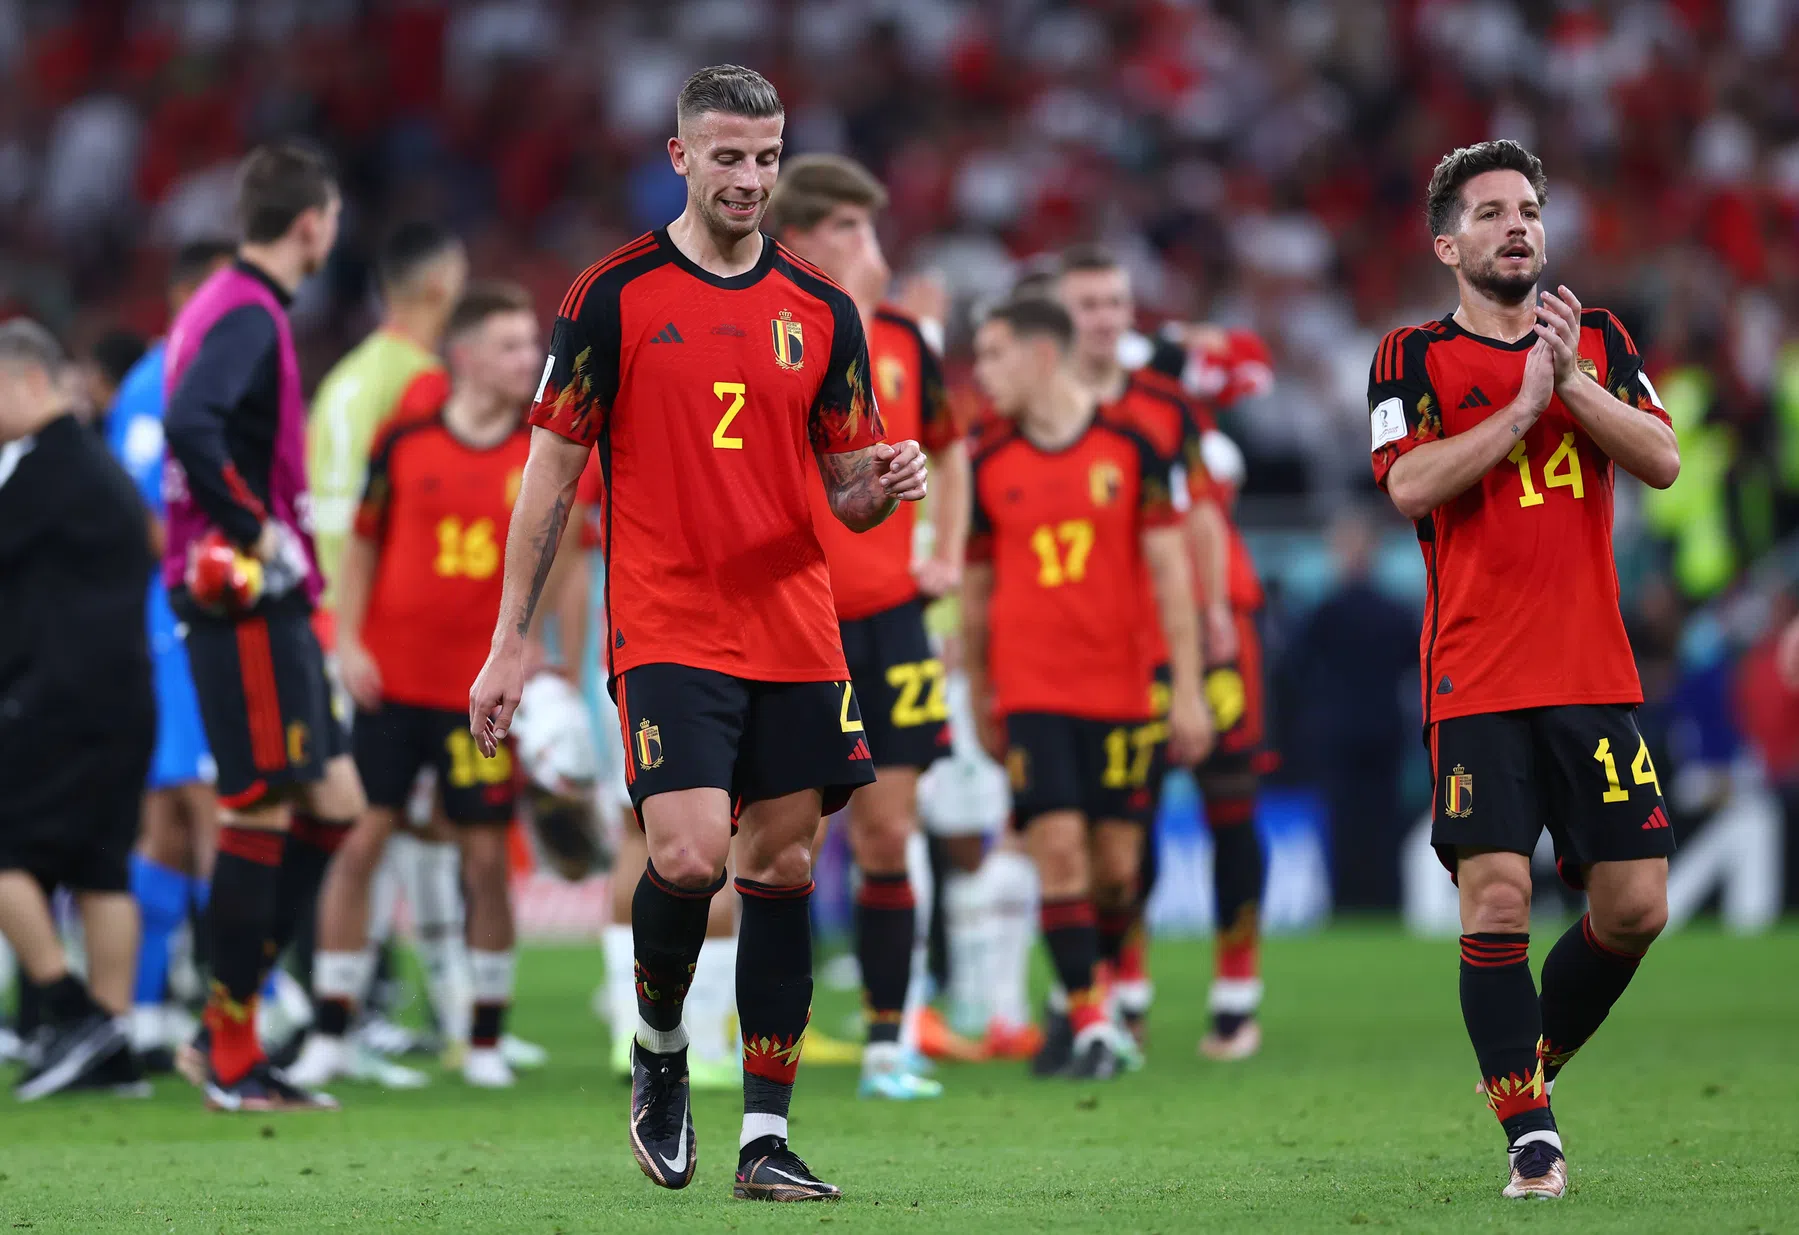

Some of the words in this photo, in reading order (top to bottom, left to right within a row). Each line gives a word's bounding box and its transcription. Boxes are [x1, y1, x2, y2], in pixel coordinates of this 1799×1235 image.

[712, 381, 746, 450] 2
[1507, 432, 1585, 508] 14
[434, 514, 500, 580] 16
[1031, 517, 1094, 588] 17
[834, 680, 865, 734] 2
[885, 657, 948, 728] 22
[1103, 718, 1172, 789] 17
[1593, 732, 1663, 803] 14
